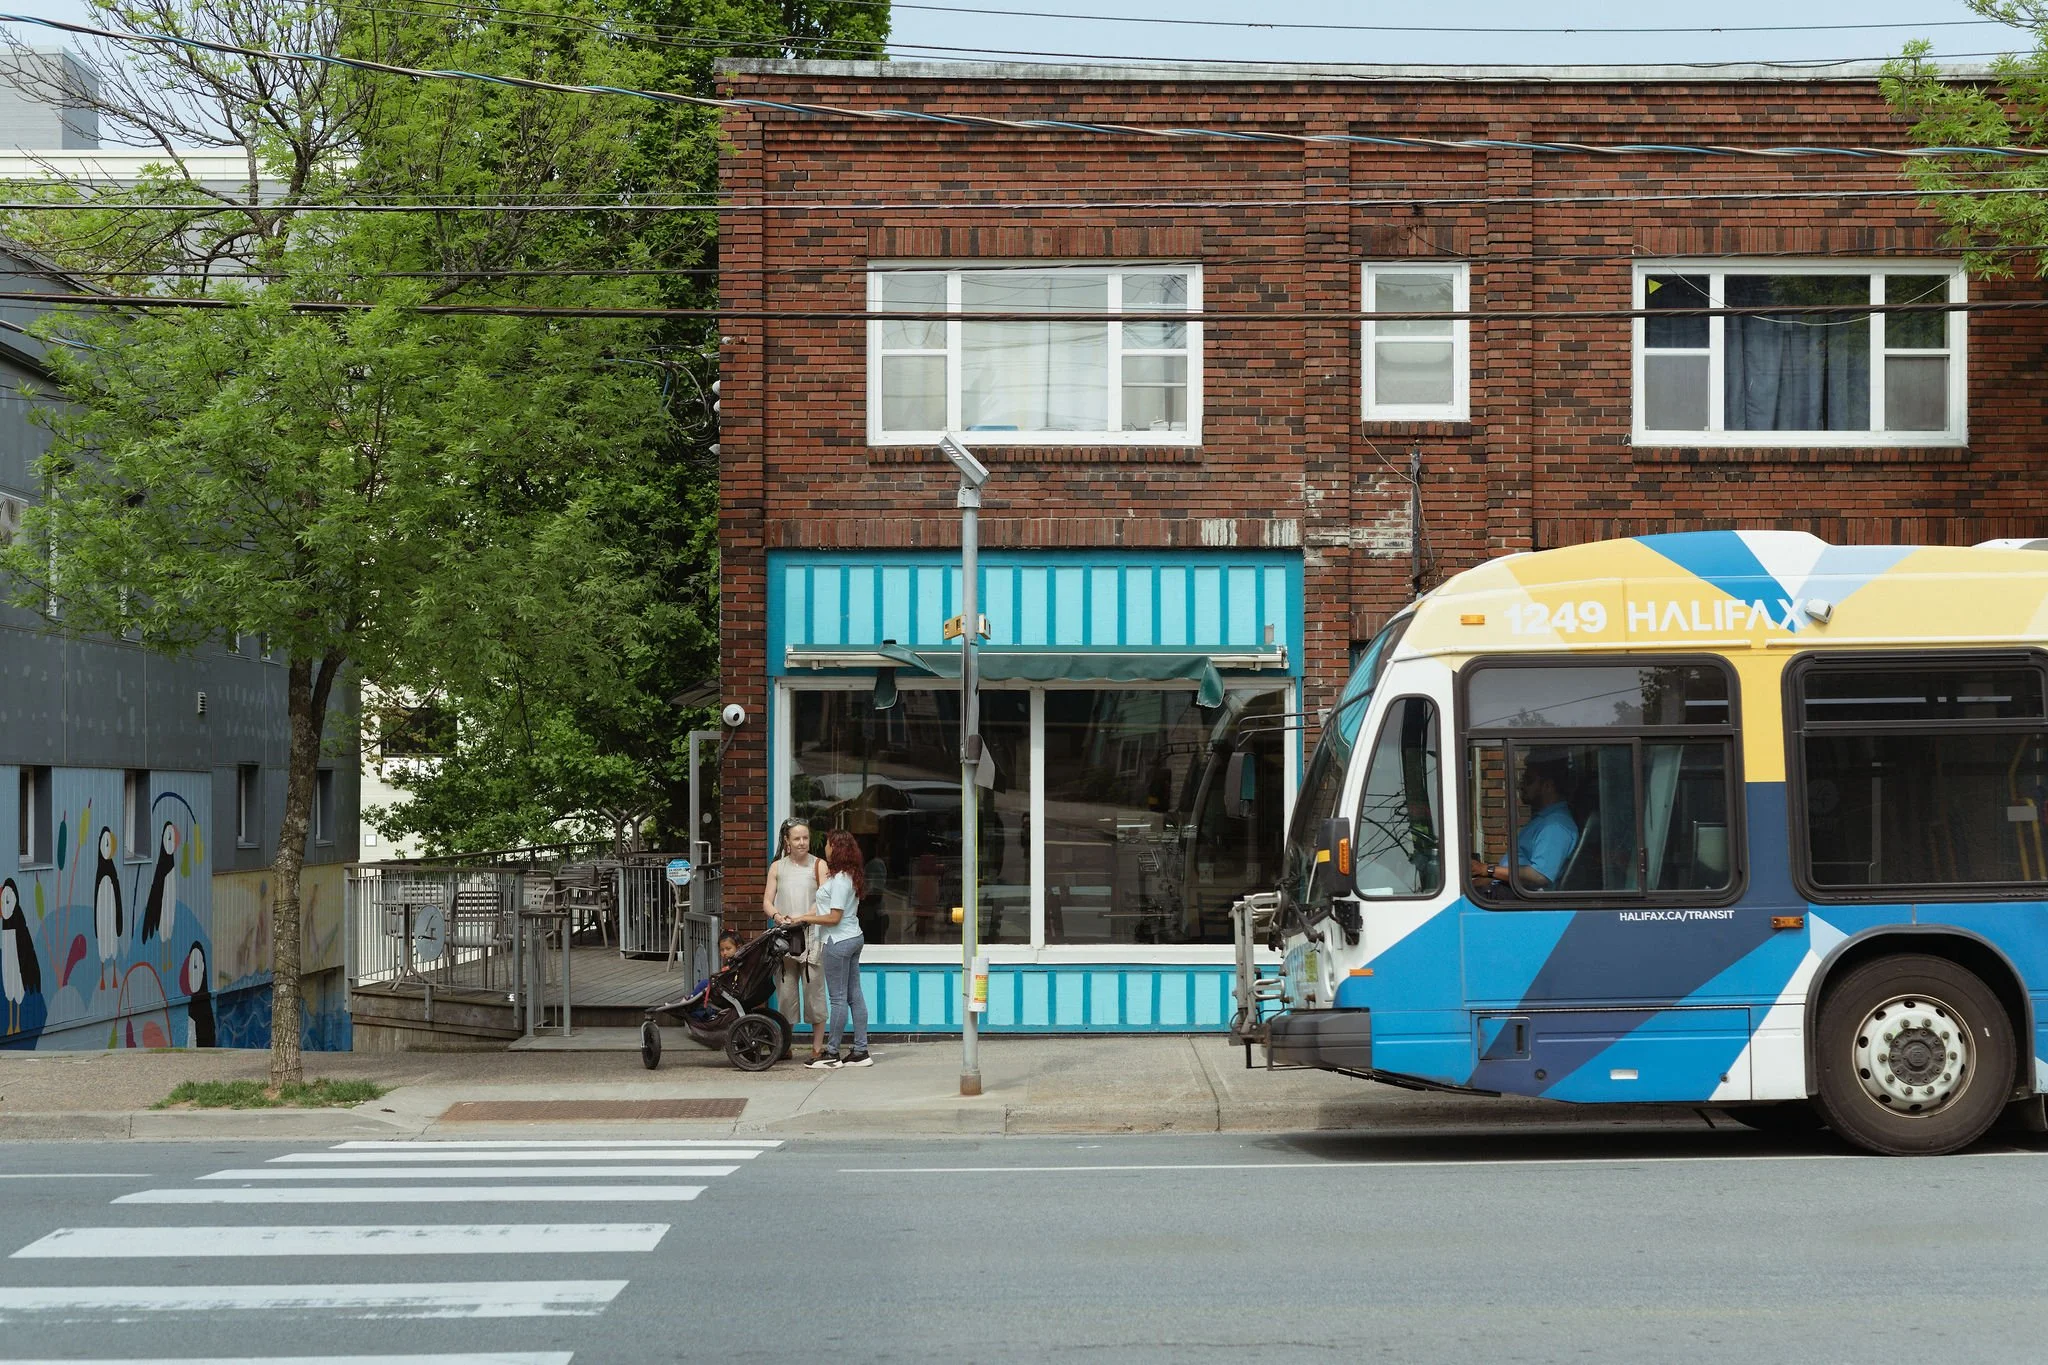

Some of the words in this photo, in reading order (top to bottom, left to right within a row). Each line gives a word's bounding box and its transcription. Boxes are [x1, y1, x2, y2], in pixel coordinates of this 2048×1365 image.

[1505, 602, 1605, 634] 1249
[1628, 600, 1804, 632] HALIFAX
[1619, 910, 1735, 922] HALIFAX.CA/TRANSIT
